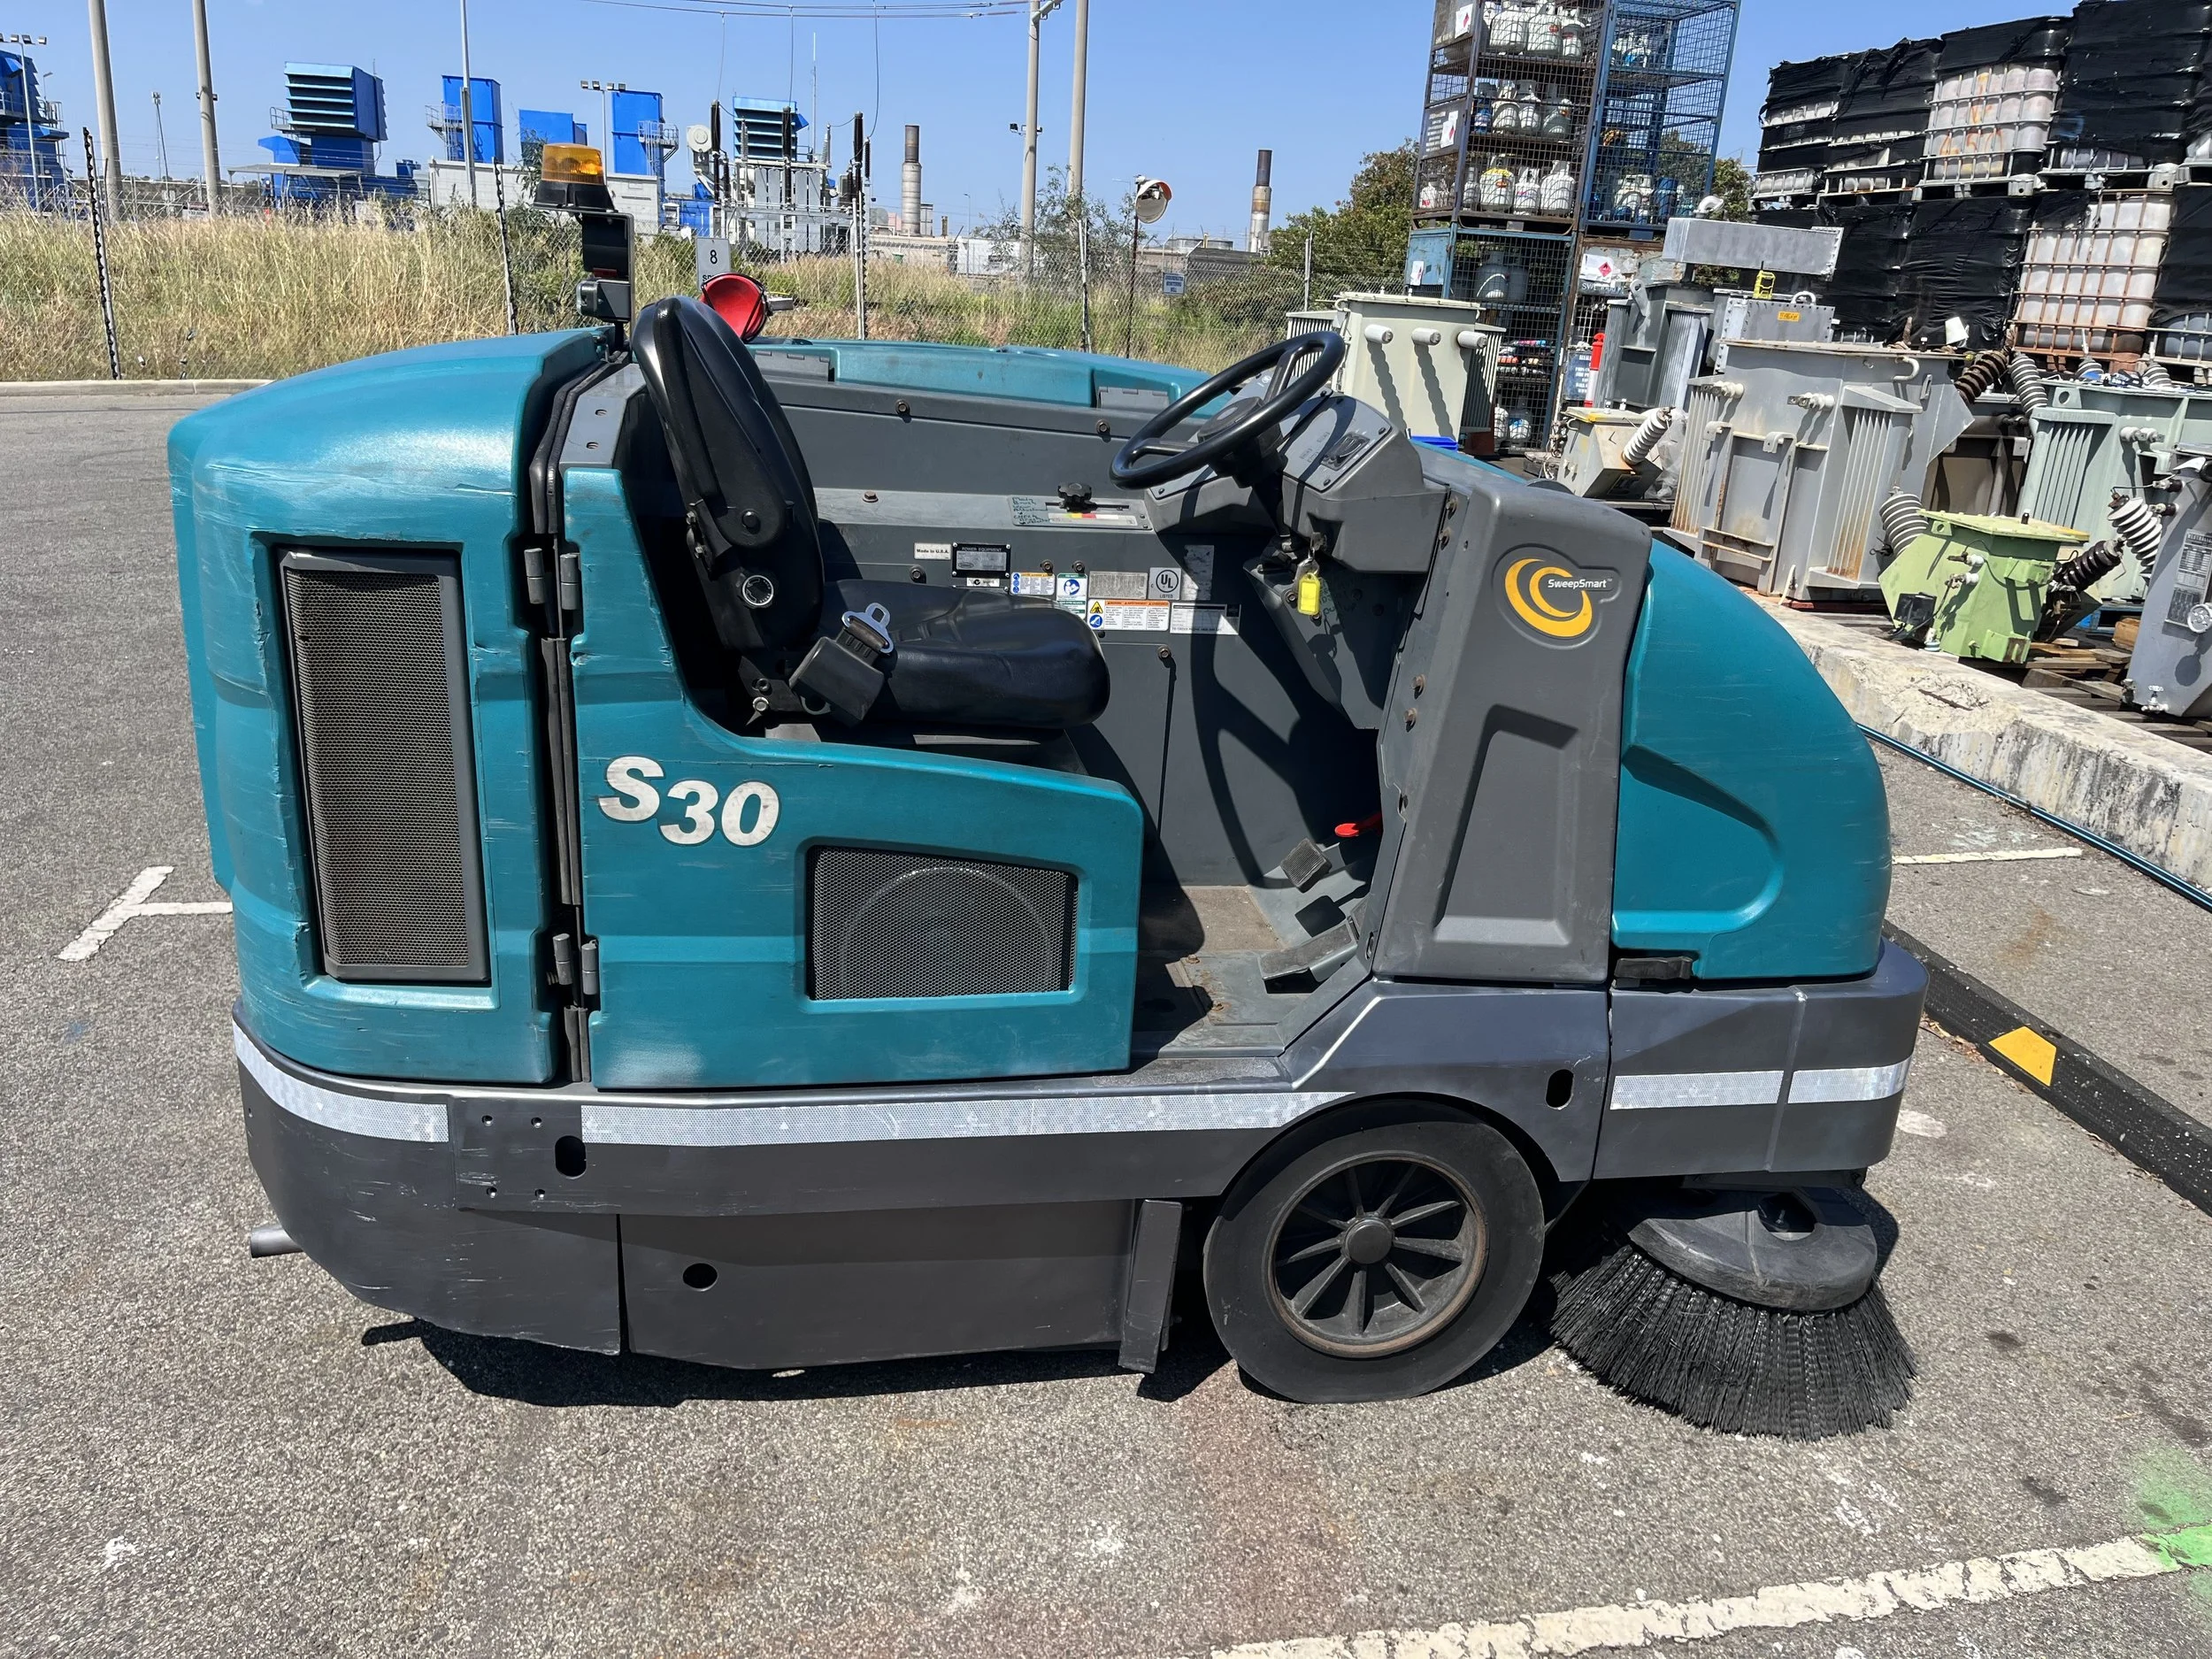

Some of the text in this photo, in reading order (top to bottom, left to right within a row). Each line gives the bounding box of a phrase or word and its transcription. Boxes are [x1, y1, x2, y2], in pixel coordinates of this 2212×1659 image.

[710, 250, 718, 264] 8
[1161, 574, 1173, 588] UL
[1548, 579, 1607, 589] SweepSmart
[599, 756, 780, 847] S30
